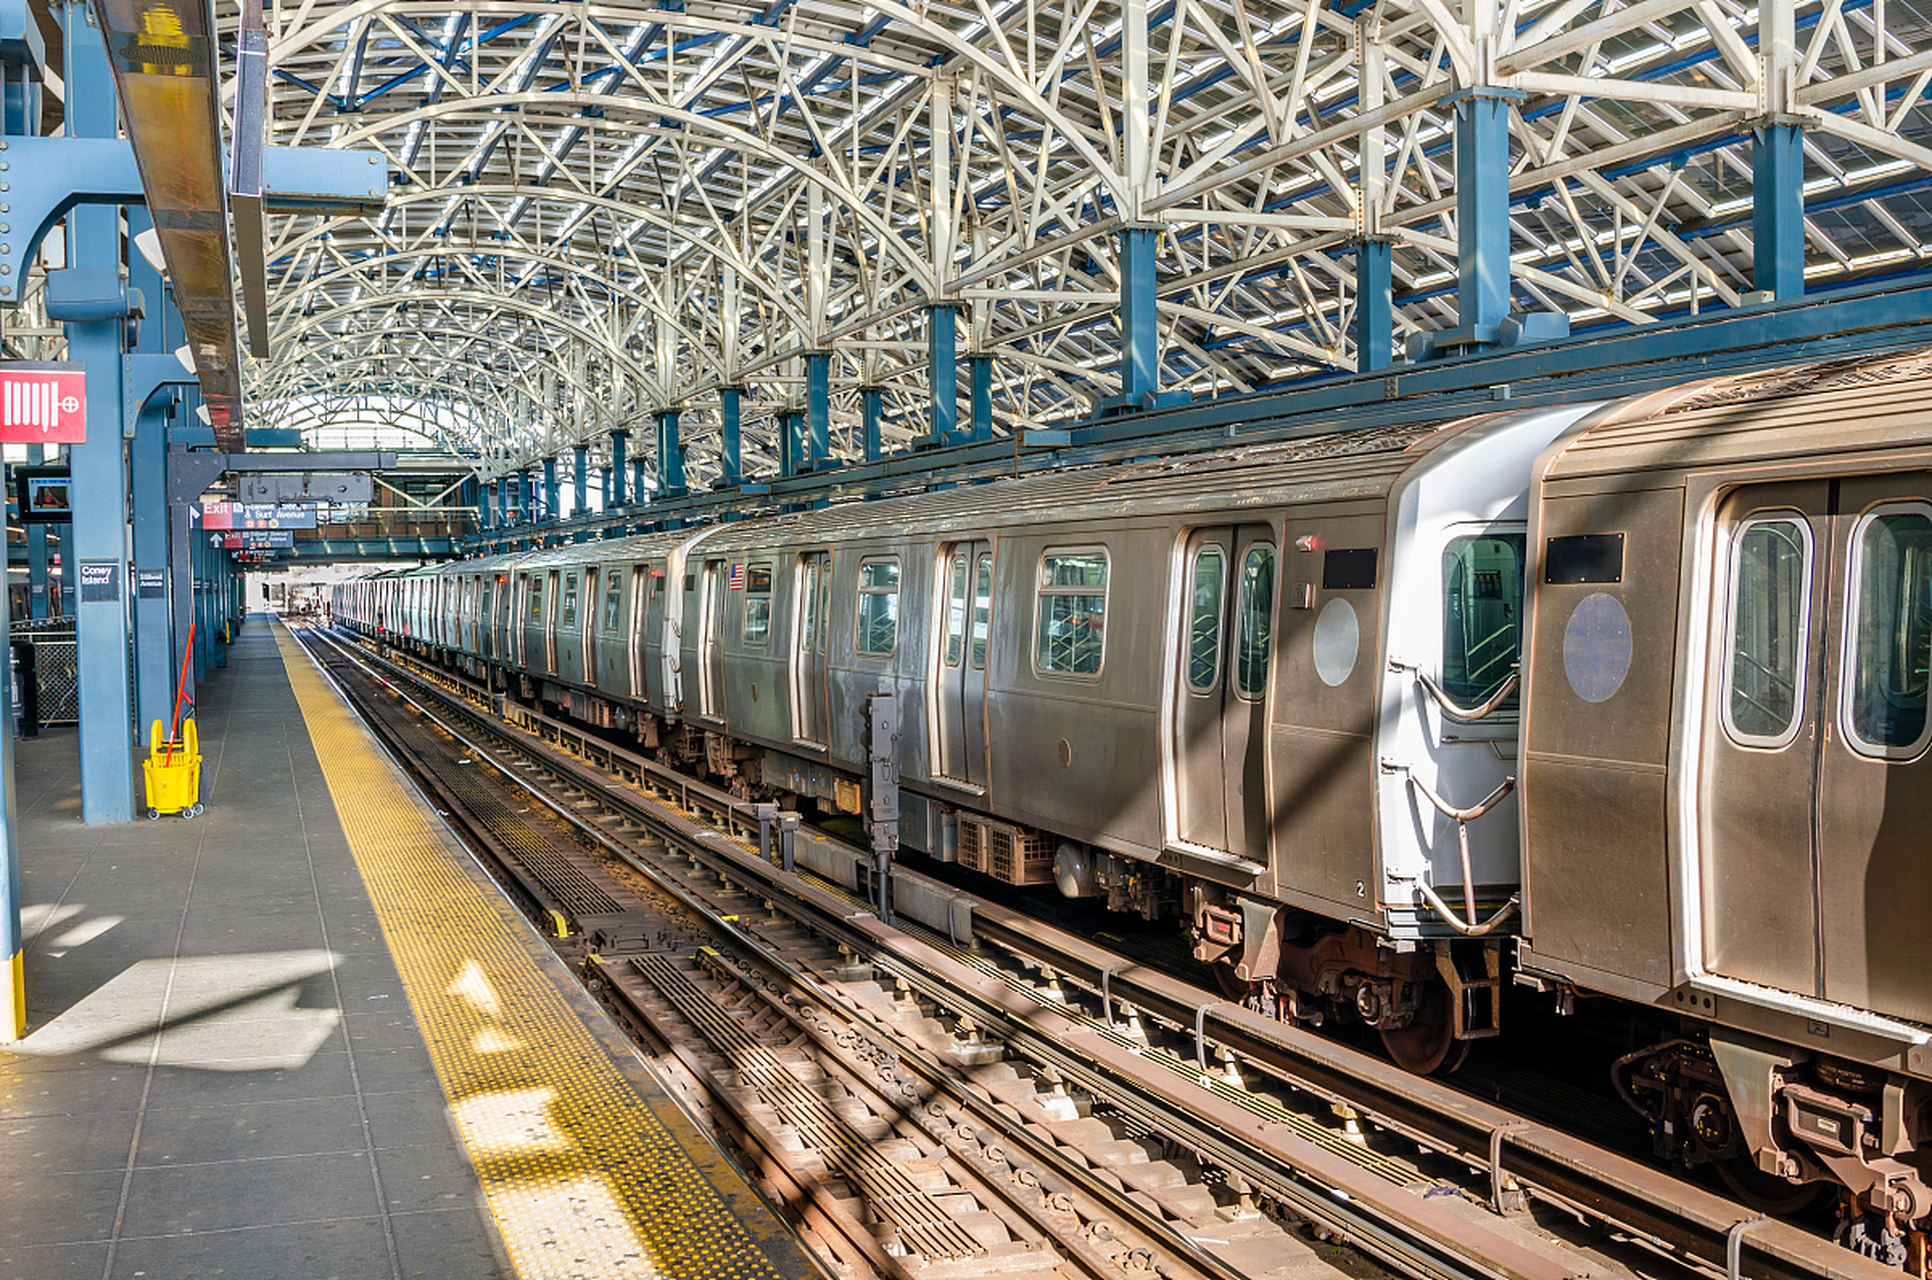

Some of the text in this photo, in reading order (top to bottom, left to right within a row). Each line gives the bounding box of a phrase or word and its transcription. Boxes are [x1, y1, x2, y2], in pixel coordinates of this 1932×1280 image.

[204, 502, 229, 514] Exit
[255, 510, 272, 519] Surf
[276, 510, 306, 519] Avenue
[82, 566, 112, 576] Coney
[82, 575, 110, 584] Island
[1357, 881, 1365, 898] 2
